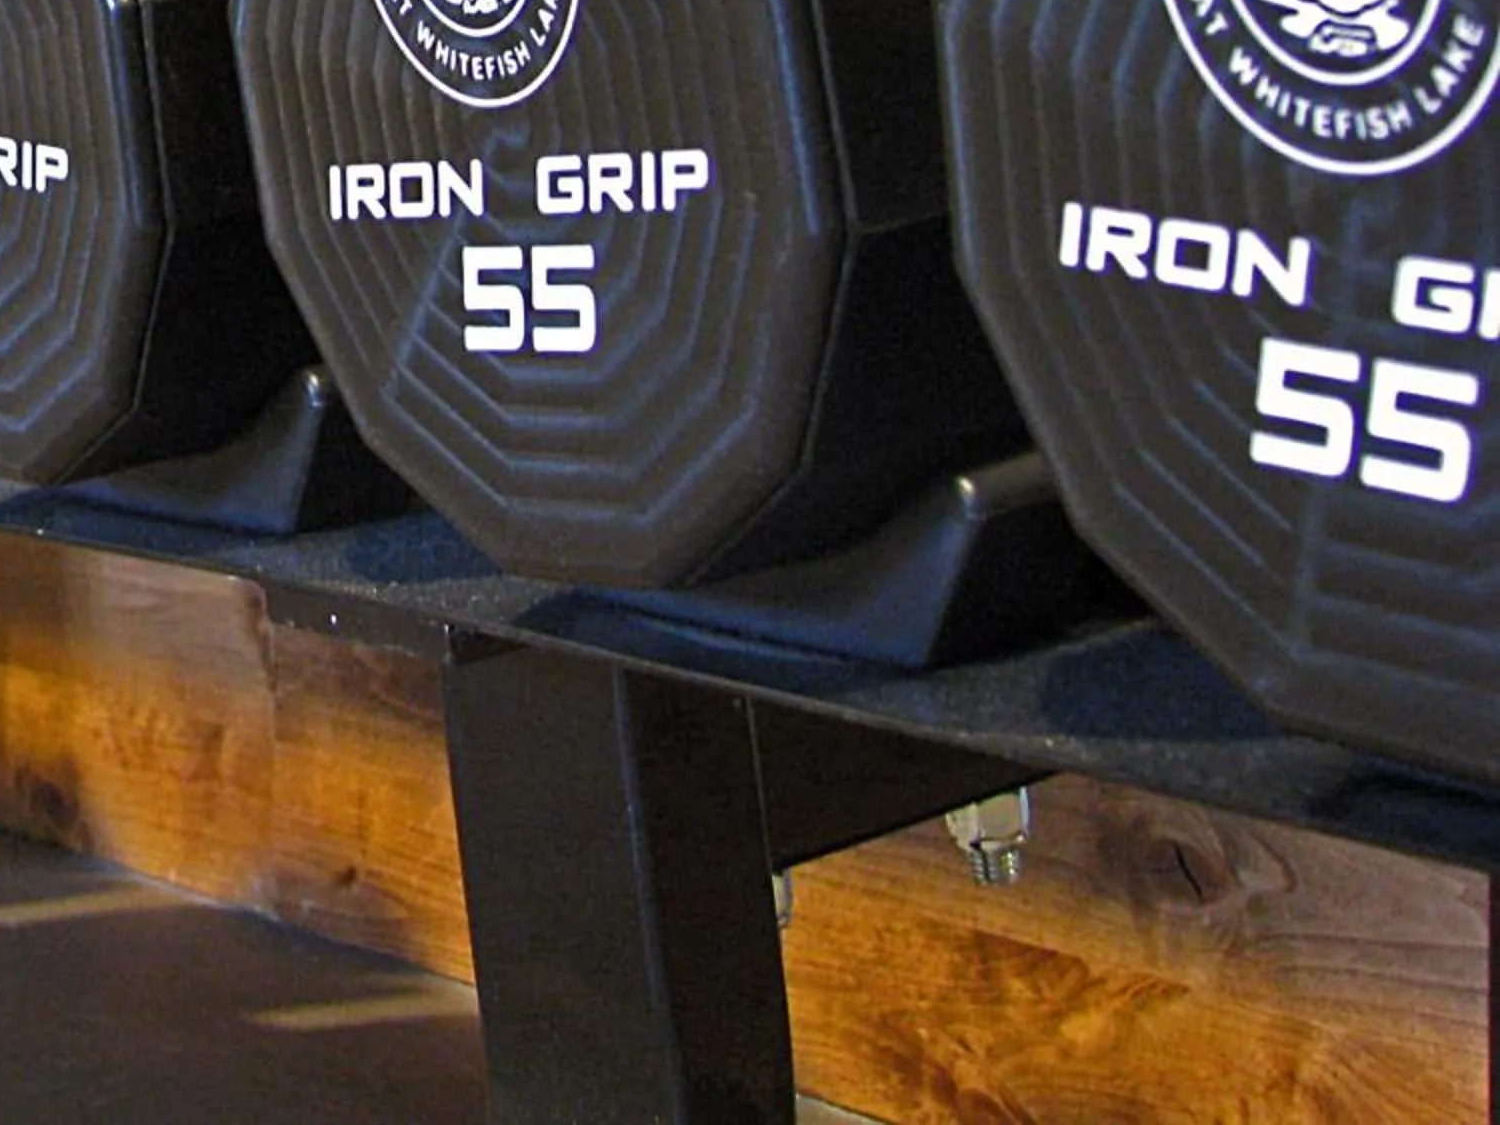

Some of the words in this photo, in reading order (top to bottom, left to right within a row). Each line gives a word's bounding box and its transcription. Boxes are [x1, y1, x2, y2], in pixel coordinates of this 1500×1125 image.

[417, 20, 531, 81] WHITEFISH
[1229, 48, 1411, 139] WHITEFISH
[1416, 17, 1484, 113] LAKE
[329, 158, 484, 220] IRON
[536, 149, 709, 214] GRIP
[462, 244, 596, 352] 55
[1059, 202, 1311, 306] IRON
[1392, 257, 1500, 340] G
[1250, 338, 1479, 502] 55
